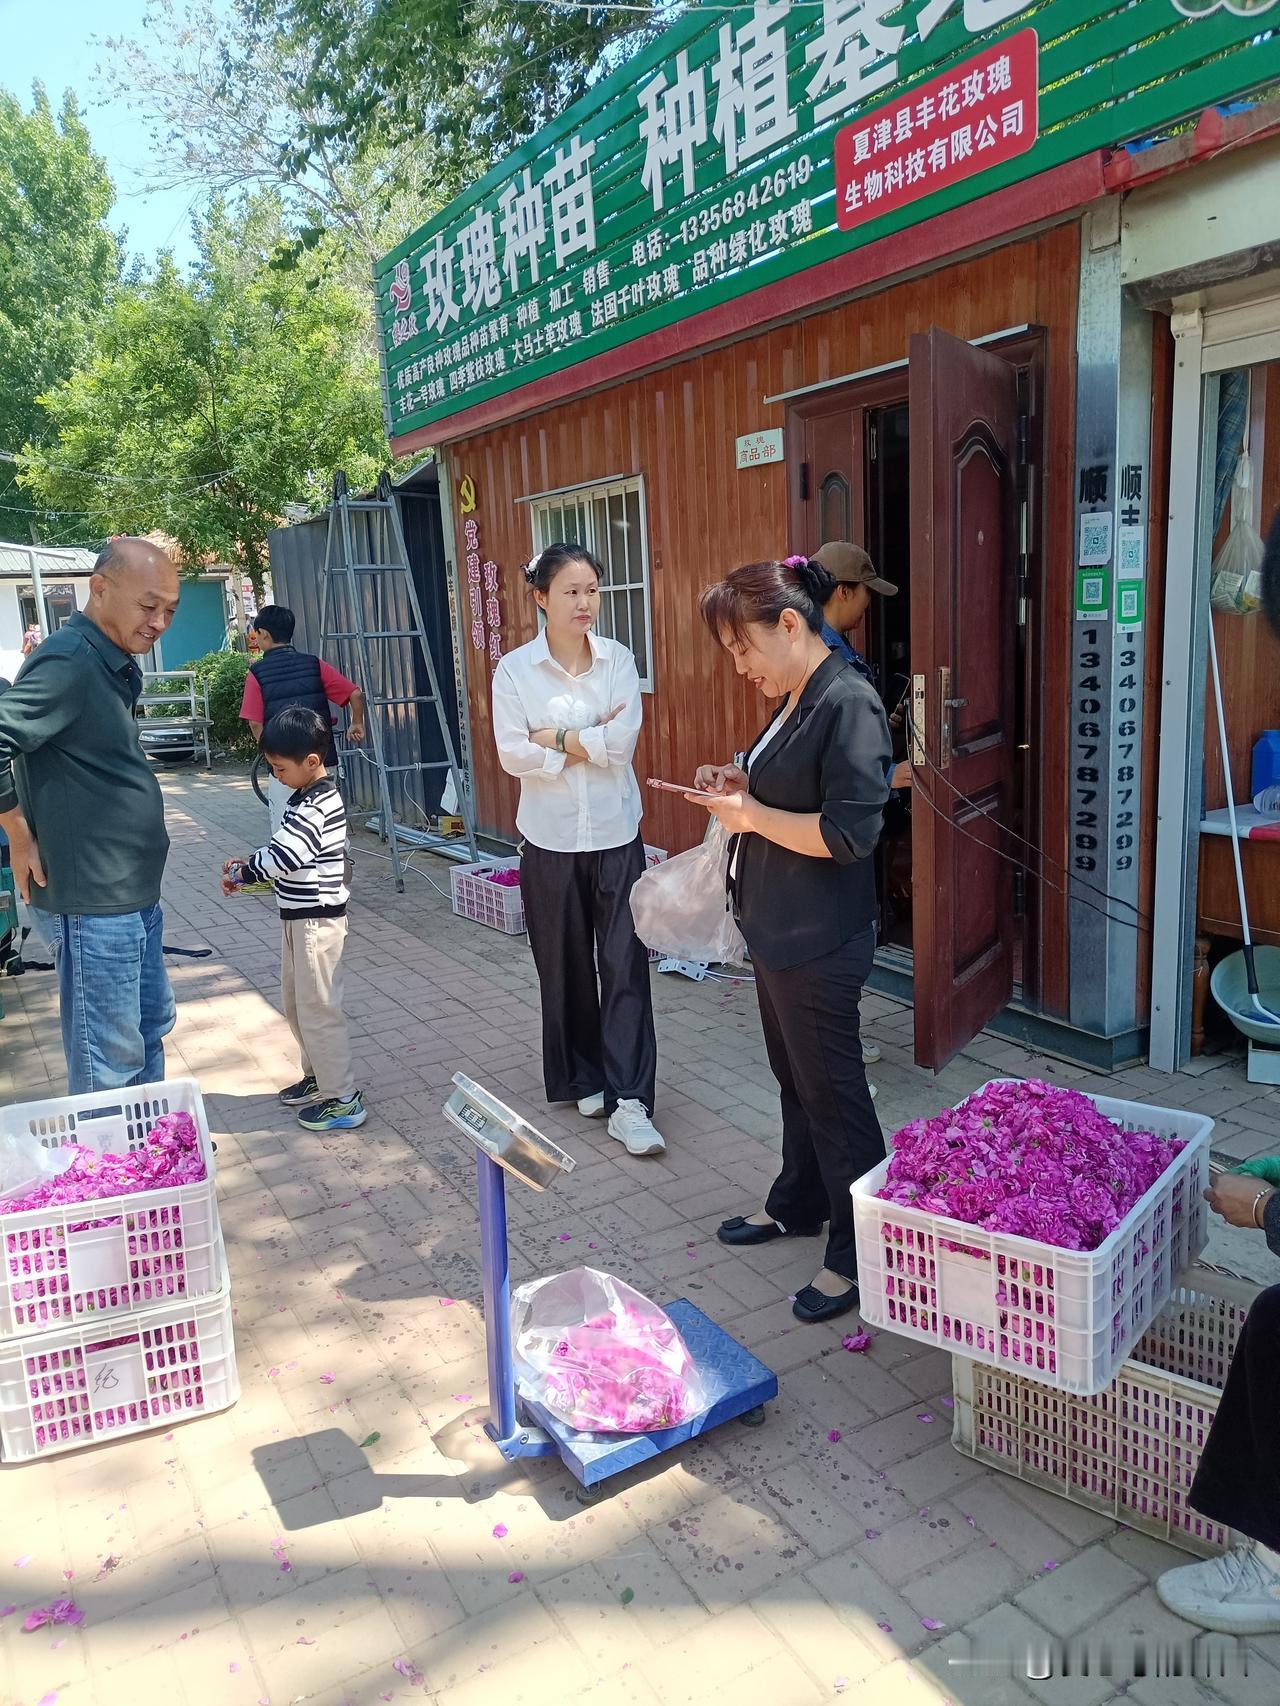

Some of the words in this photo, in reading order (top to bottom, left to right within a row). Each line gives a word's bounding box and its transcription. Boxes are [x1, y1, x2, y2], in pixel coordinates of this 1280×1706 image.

[420, 135, 597, 335] 玫瑰种苗
[636, 0, 1033, 212] 种植基
[844, 101, 1025, 213] 生物科技有限公司
[852, 55, 1013, 164] 夏津县丰花玫瑰
[396, 313, 509, 391] 优质高产良种玫瑰品种苗繁育
[516, 297, 540, 330] 种植
[549, 282, 575, 313] 加工
[583, 259, 611, 296] 销售
[399, 377, 446, 415] 丰花一号玫瑰
[512, 310, 582, 363] 大马士革玫瑰
[591, 262, 681, 328] 法国千叶玫瑰
[693, 197, 814, 283] 品种绿化玫瑰
[464, 519, 486, 650] 党建引领
[483, 560, 503, 676] 玫瑰红
[1075, 629, 1101, 872] 13406787299
